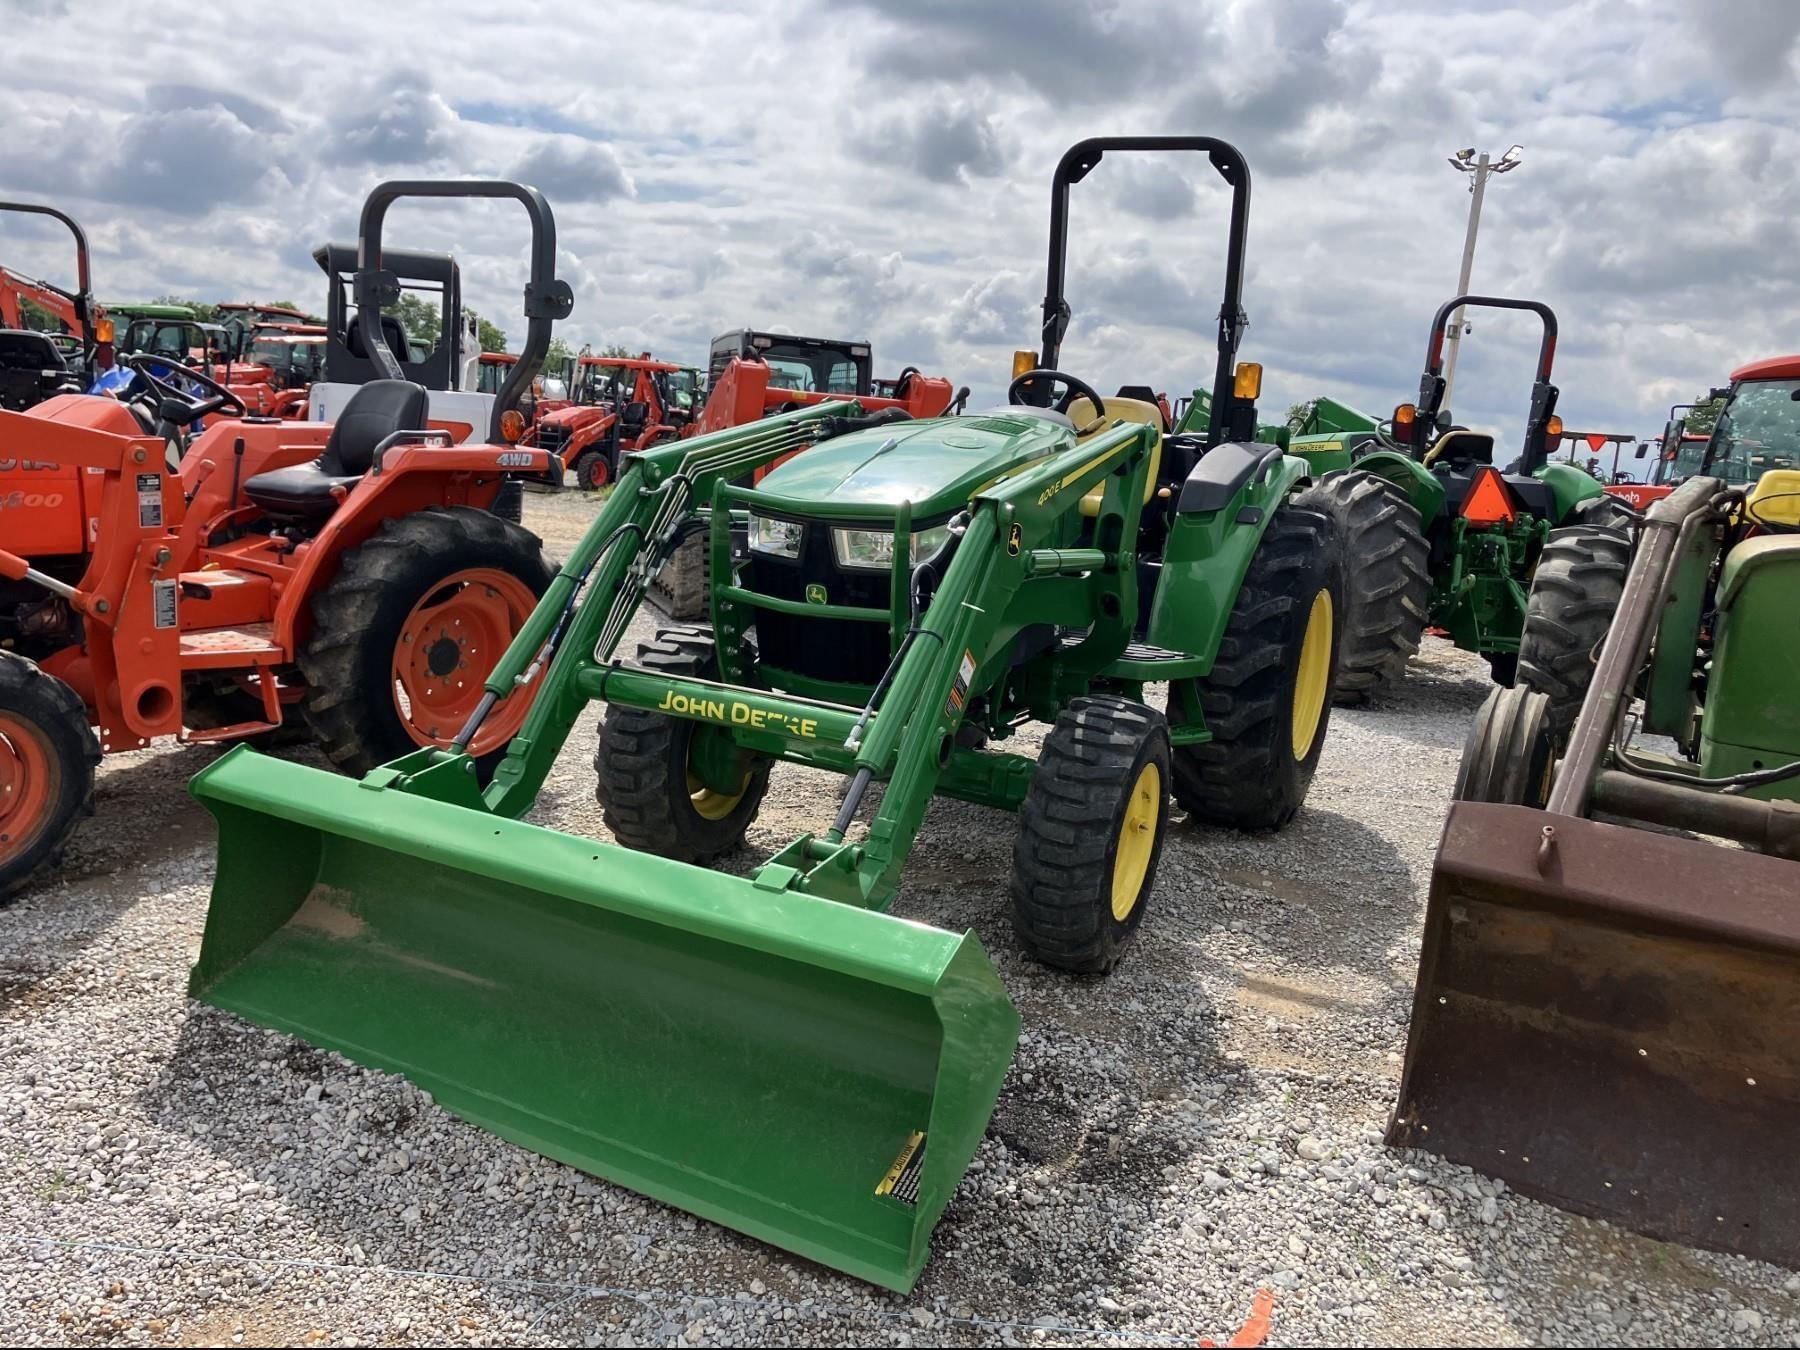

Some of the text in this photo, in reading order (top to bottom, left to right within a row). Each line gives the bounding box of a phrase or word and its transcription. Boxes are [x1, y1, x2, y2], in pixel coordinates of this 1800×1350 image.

[496, 452, 533, 467] 4WD
[658, 690, 725, 721] JOHN
[894, 1143, 915, 1171] CAUTION
